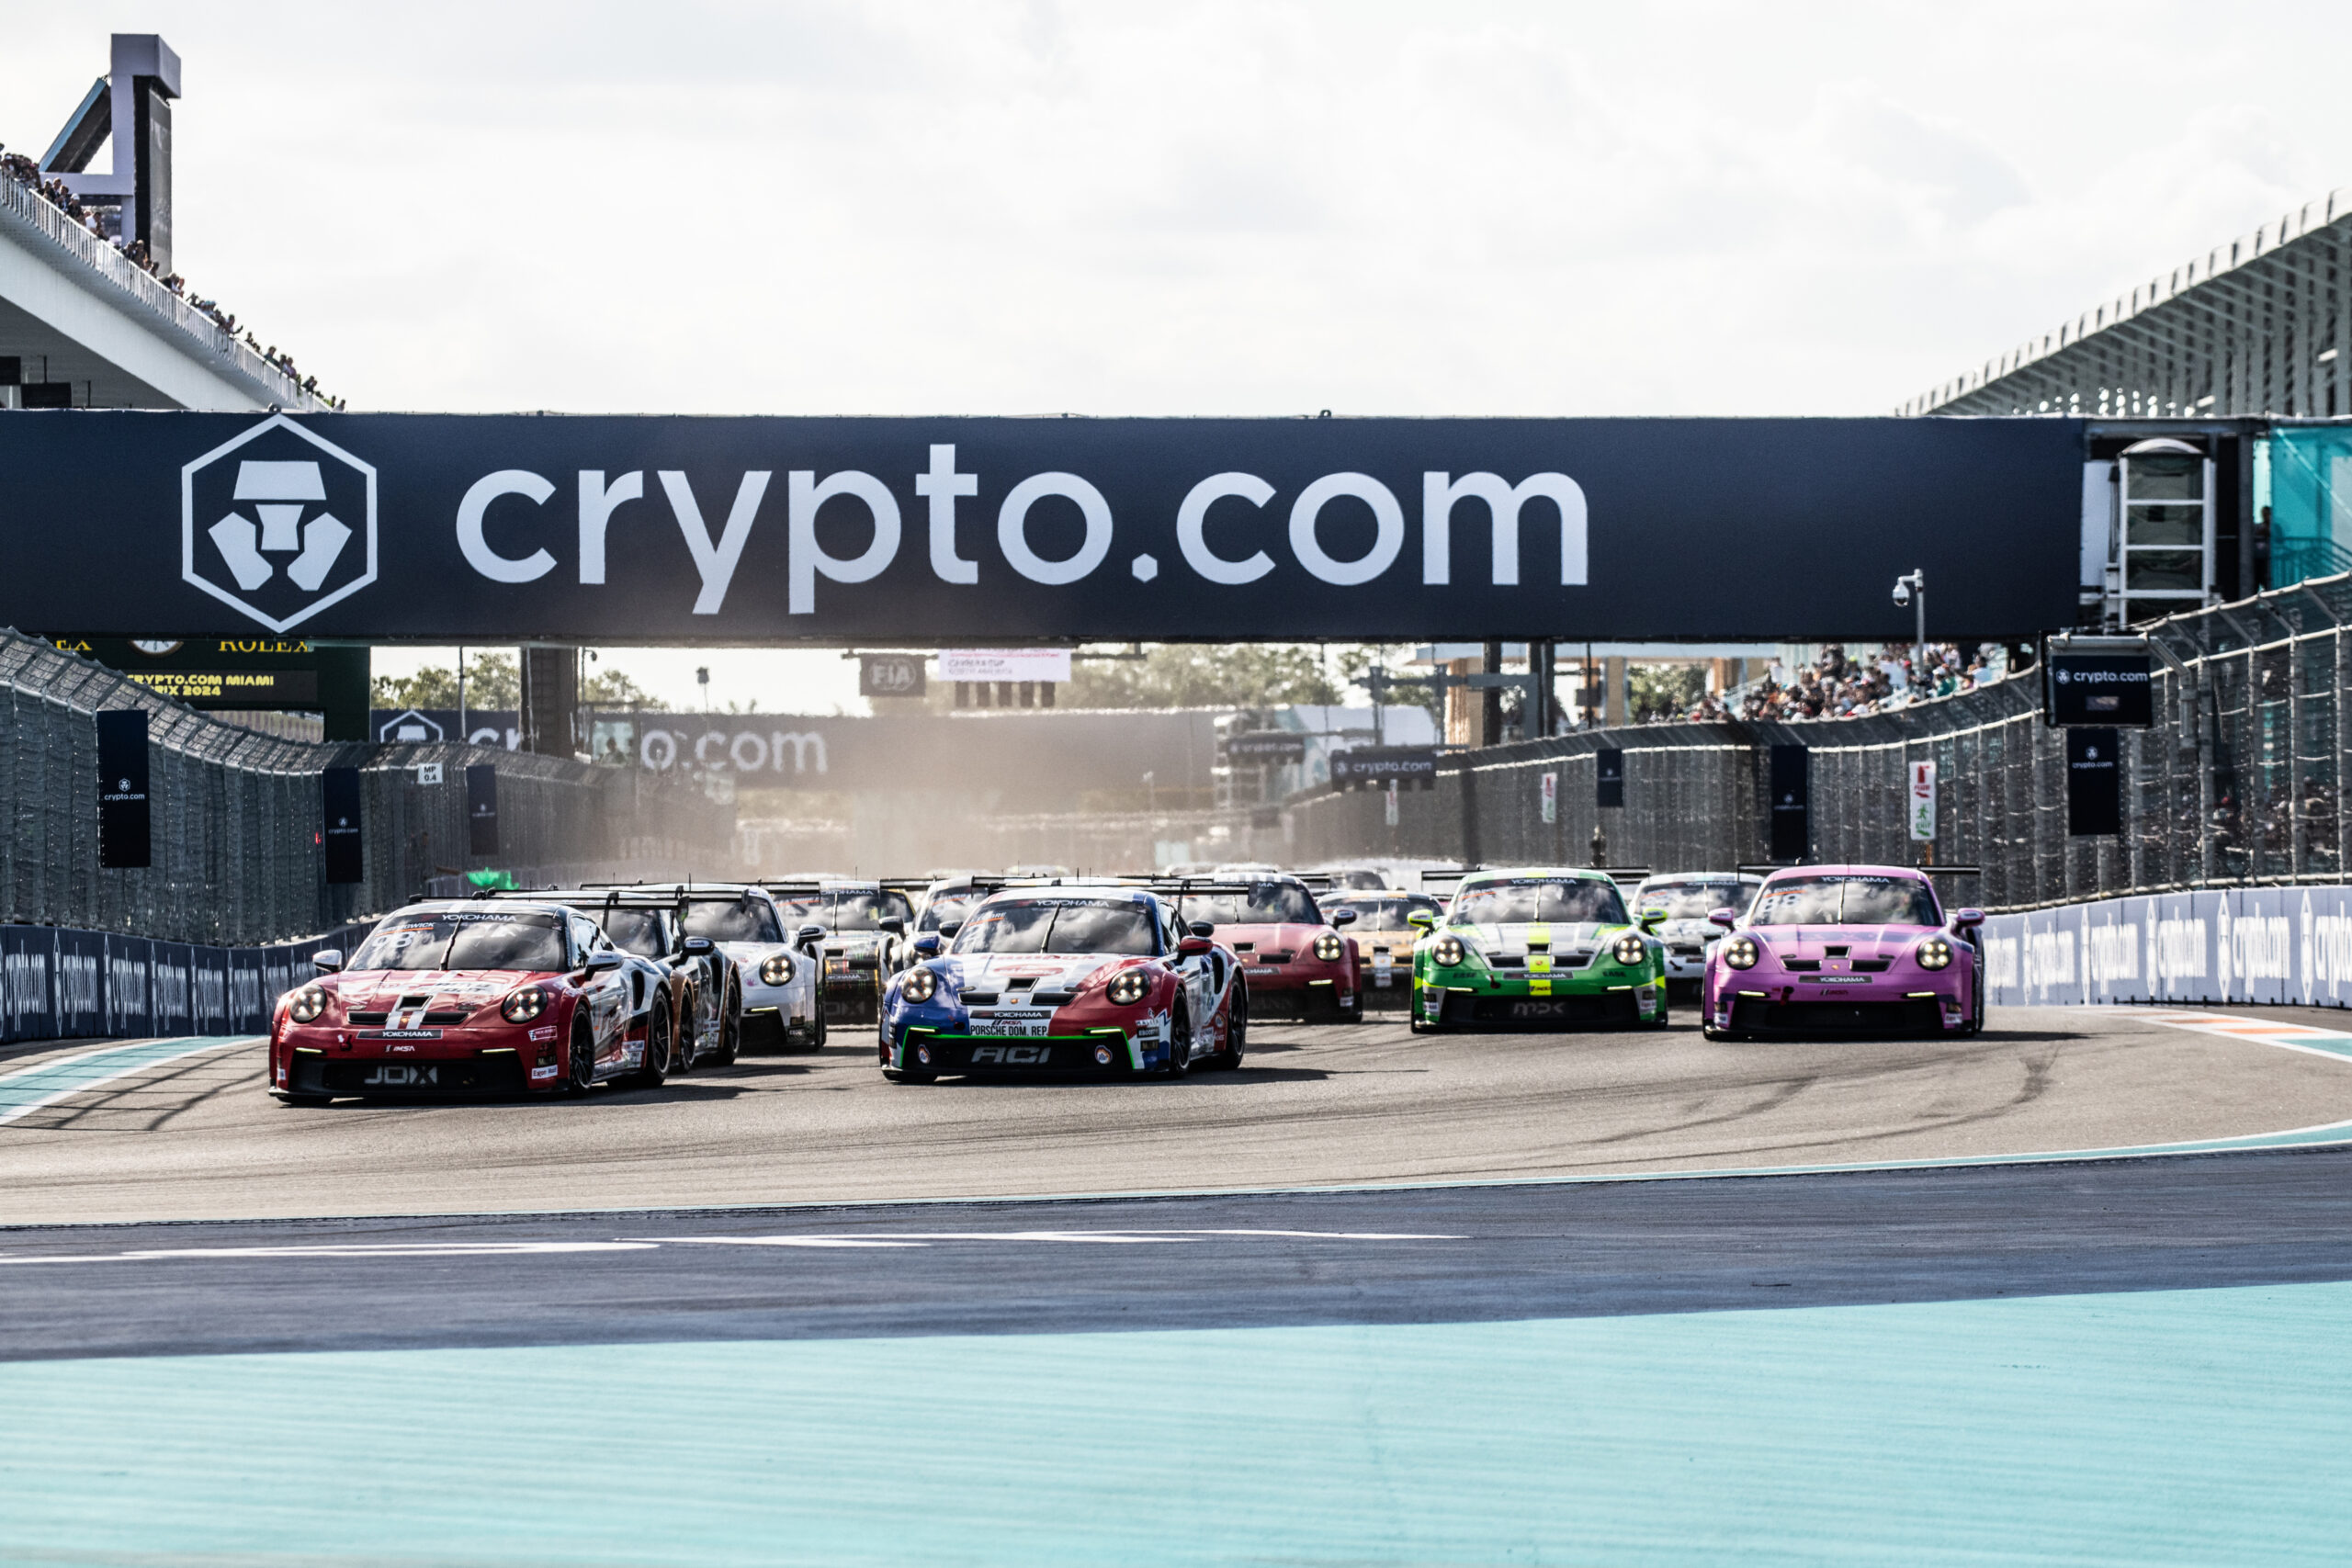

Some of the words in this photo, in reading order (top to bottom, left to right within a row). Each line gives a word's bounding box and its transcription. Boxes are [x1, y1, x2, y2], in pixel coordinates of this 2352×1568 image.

[456, 443, 1588, 615] crypto.com
[225, 674, 274, 686] MIAMI
[872, 664, 910, 685] FIA
[2073, 671, 2148, 684] crypto.com
[151, 685, 179, 695] RIX
[183, 685, 221, 695] 2024
[1352, 761, 1432, 775] crypto.com
[2072, 761, 2113, 770] crypto.com
[104, 792, 145, 801] crypto.com
[1036, 899, 1110, 908] YOKOHAMA
[442, 914, 517, 922] YOKOHAMA
[372, 931, 415, 948] 98
[970, 1025, 1007, 1036] PORSCHE
[1008, 1025, 1029, 1036] DOM.
[971, 1046, 1052, 1064] ACI
[364, 1066, 438, 1085] JDX
